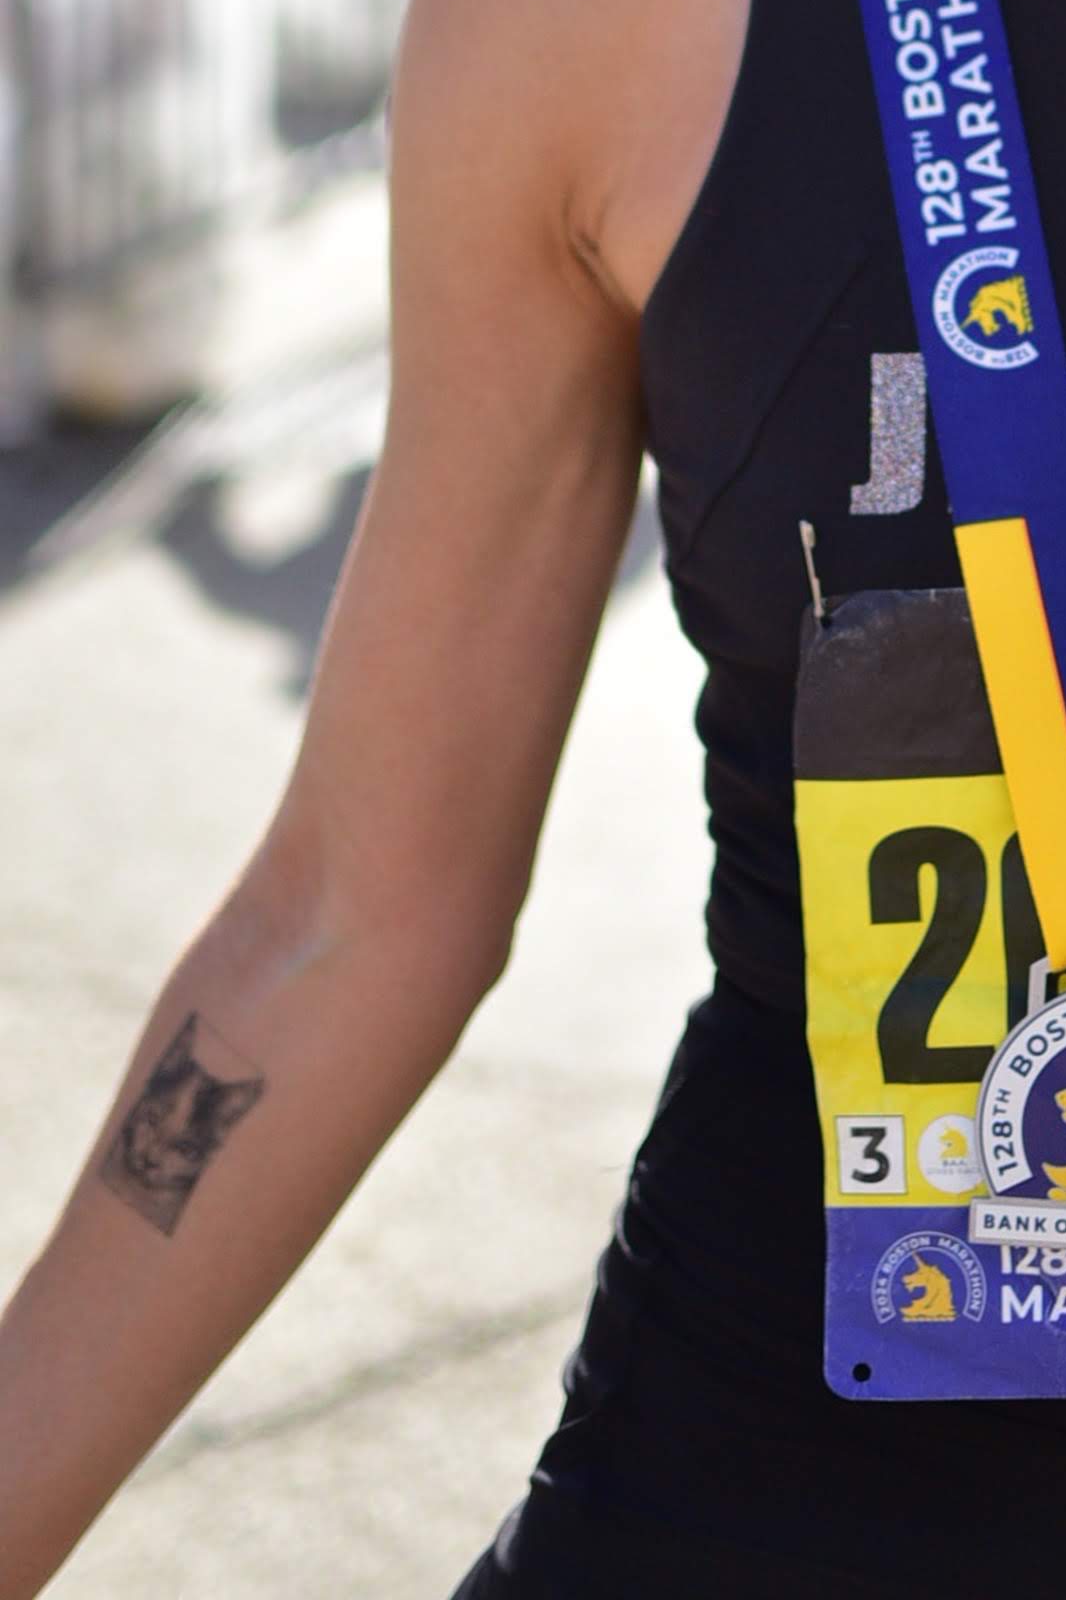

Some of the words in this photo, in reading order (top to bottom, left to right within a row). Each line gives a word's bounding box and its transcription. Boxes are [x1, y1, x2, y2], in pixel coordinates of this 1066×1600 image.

[911, 130, 966, 245] 128TH
[941, 251, 1010, 301] MARATHON
[941, 311, 986, 360] BOSTON
[850, 1127, 890, 1184] 3
[992, 1089, 1018, 1177] 128TH
[983, 1214, 1047, 1233] BANK
[882, 1236, 931, 1274] BOSTON
[938, 1237, 983, 1311] MARATHON
